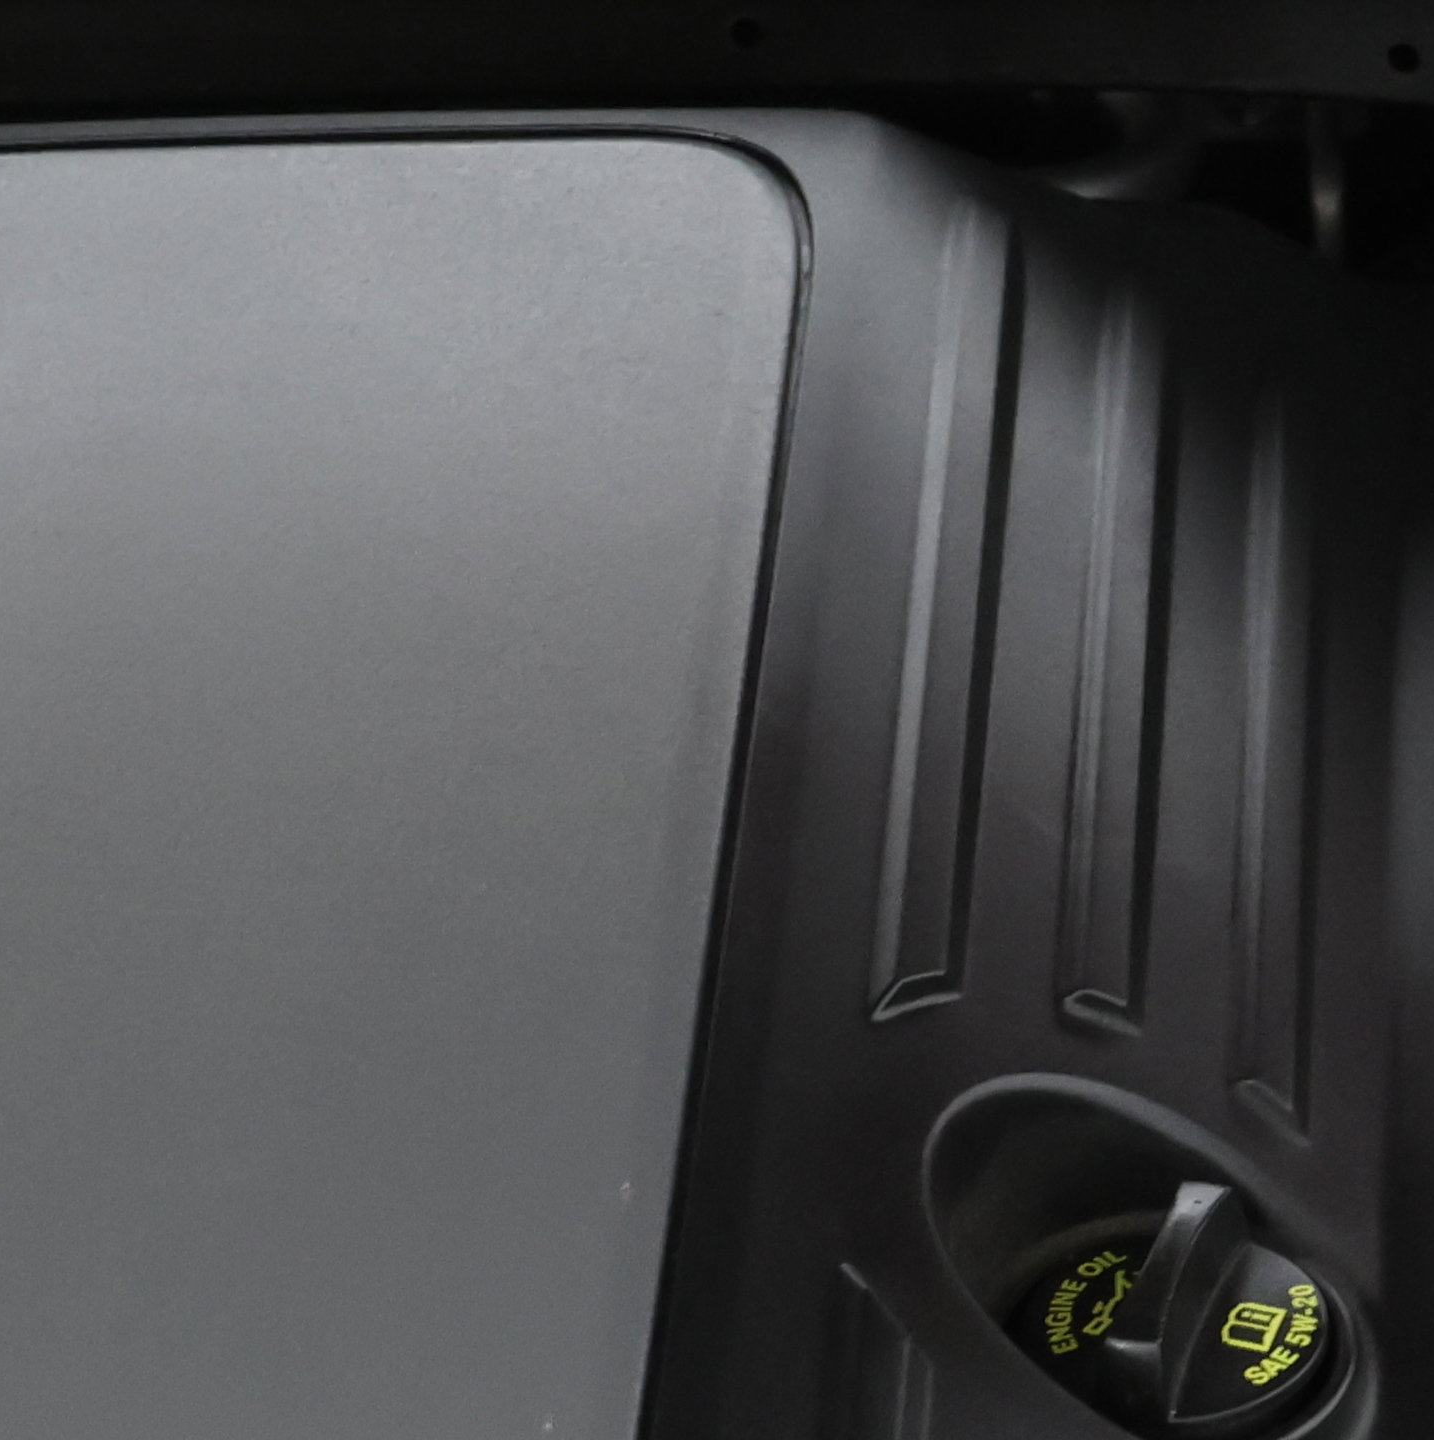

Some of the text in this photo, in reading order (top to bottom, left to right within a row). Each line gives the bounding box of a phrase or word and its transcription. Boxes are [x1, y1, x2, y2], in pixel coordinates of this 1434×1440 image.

[1043, 1250, 1128, 1355] ENGINE OIL
[1243, 1283, 1319, 1387] SAE 5W-20
